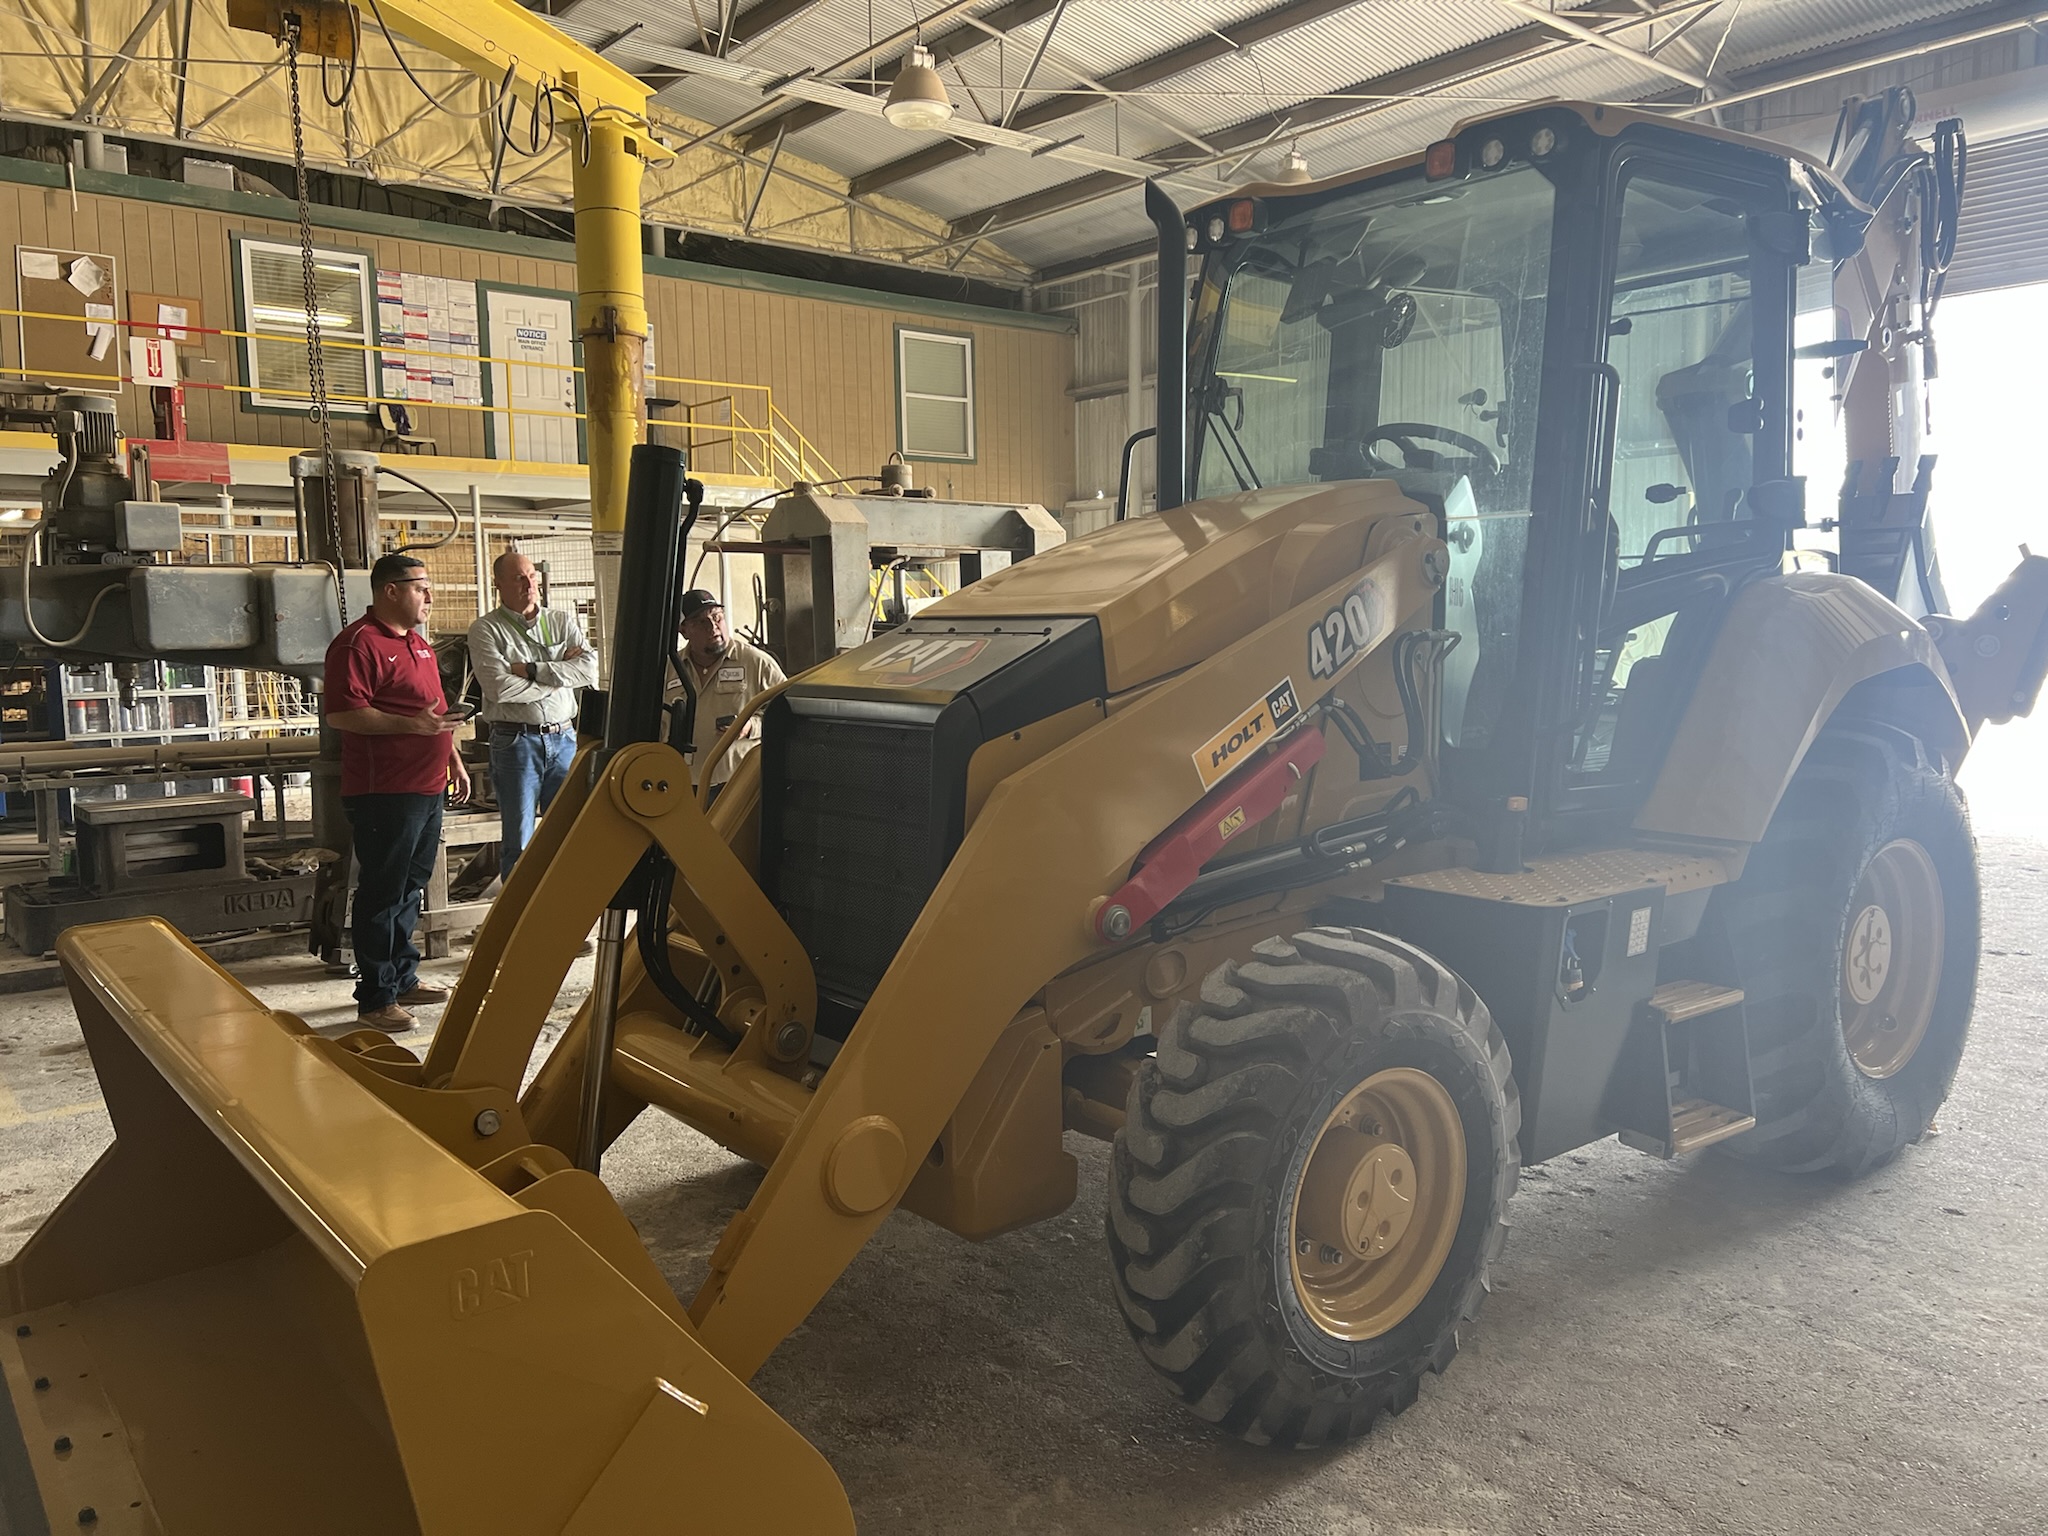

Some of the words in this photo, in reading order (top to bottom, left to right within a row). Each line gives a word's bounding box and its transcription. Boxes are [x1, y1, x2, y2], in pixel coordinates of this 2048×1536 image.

[518, 329, 546, 339] NOTICE
[858, 639, 977, 674] CAT
[1211, 713, 1264, 768] HOLT
[1271, 690, 1293, 719] CAT
[225, 888, 294, 914] IKEDA
[449, 1249, 534, 1320] CAT
